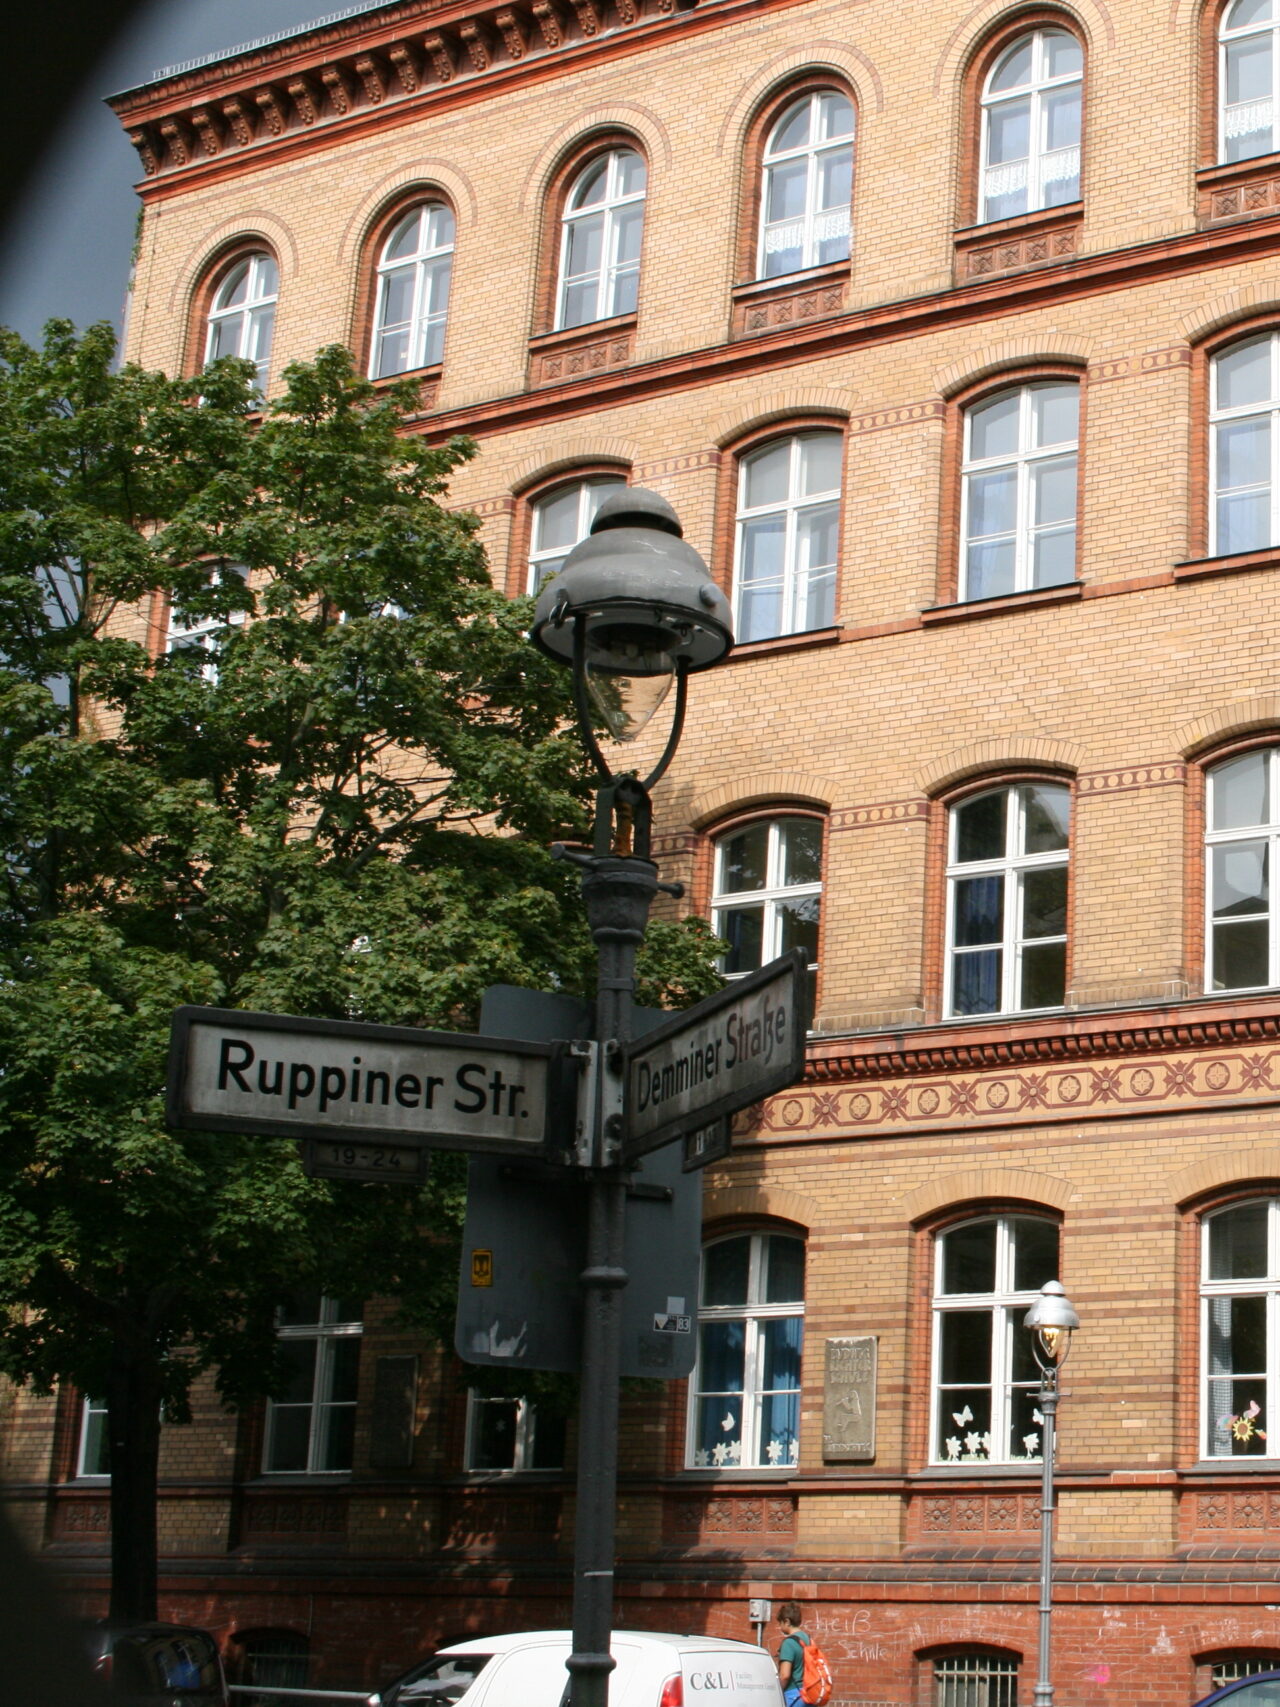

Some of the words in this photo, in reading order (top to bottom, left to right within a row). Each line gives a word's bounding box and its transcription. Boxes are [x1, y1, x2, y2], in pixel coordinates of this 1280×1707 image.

[218, 1038, 444, 1112] Ruppiner
[454, 1063, 529, 1119] Str.
[637, 1038, 722, 1113] Demminer
[725, 1000, 786, 1070] Straße
[332, 1147, 401, 1168] 19-24
[690, 1671, 729, 1691] C&L
